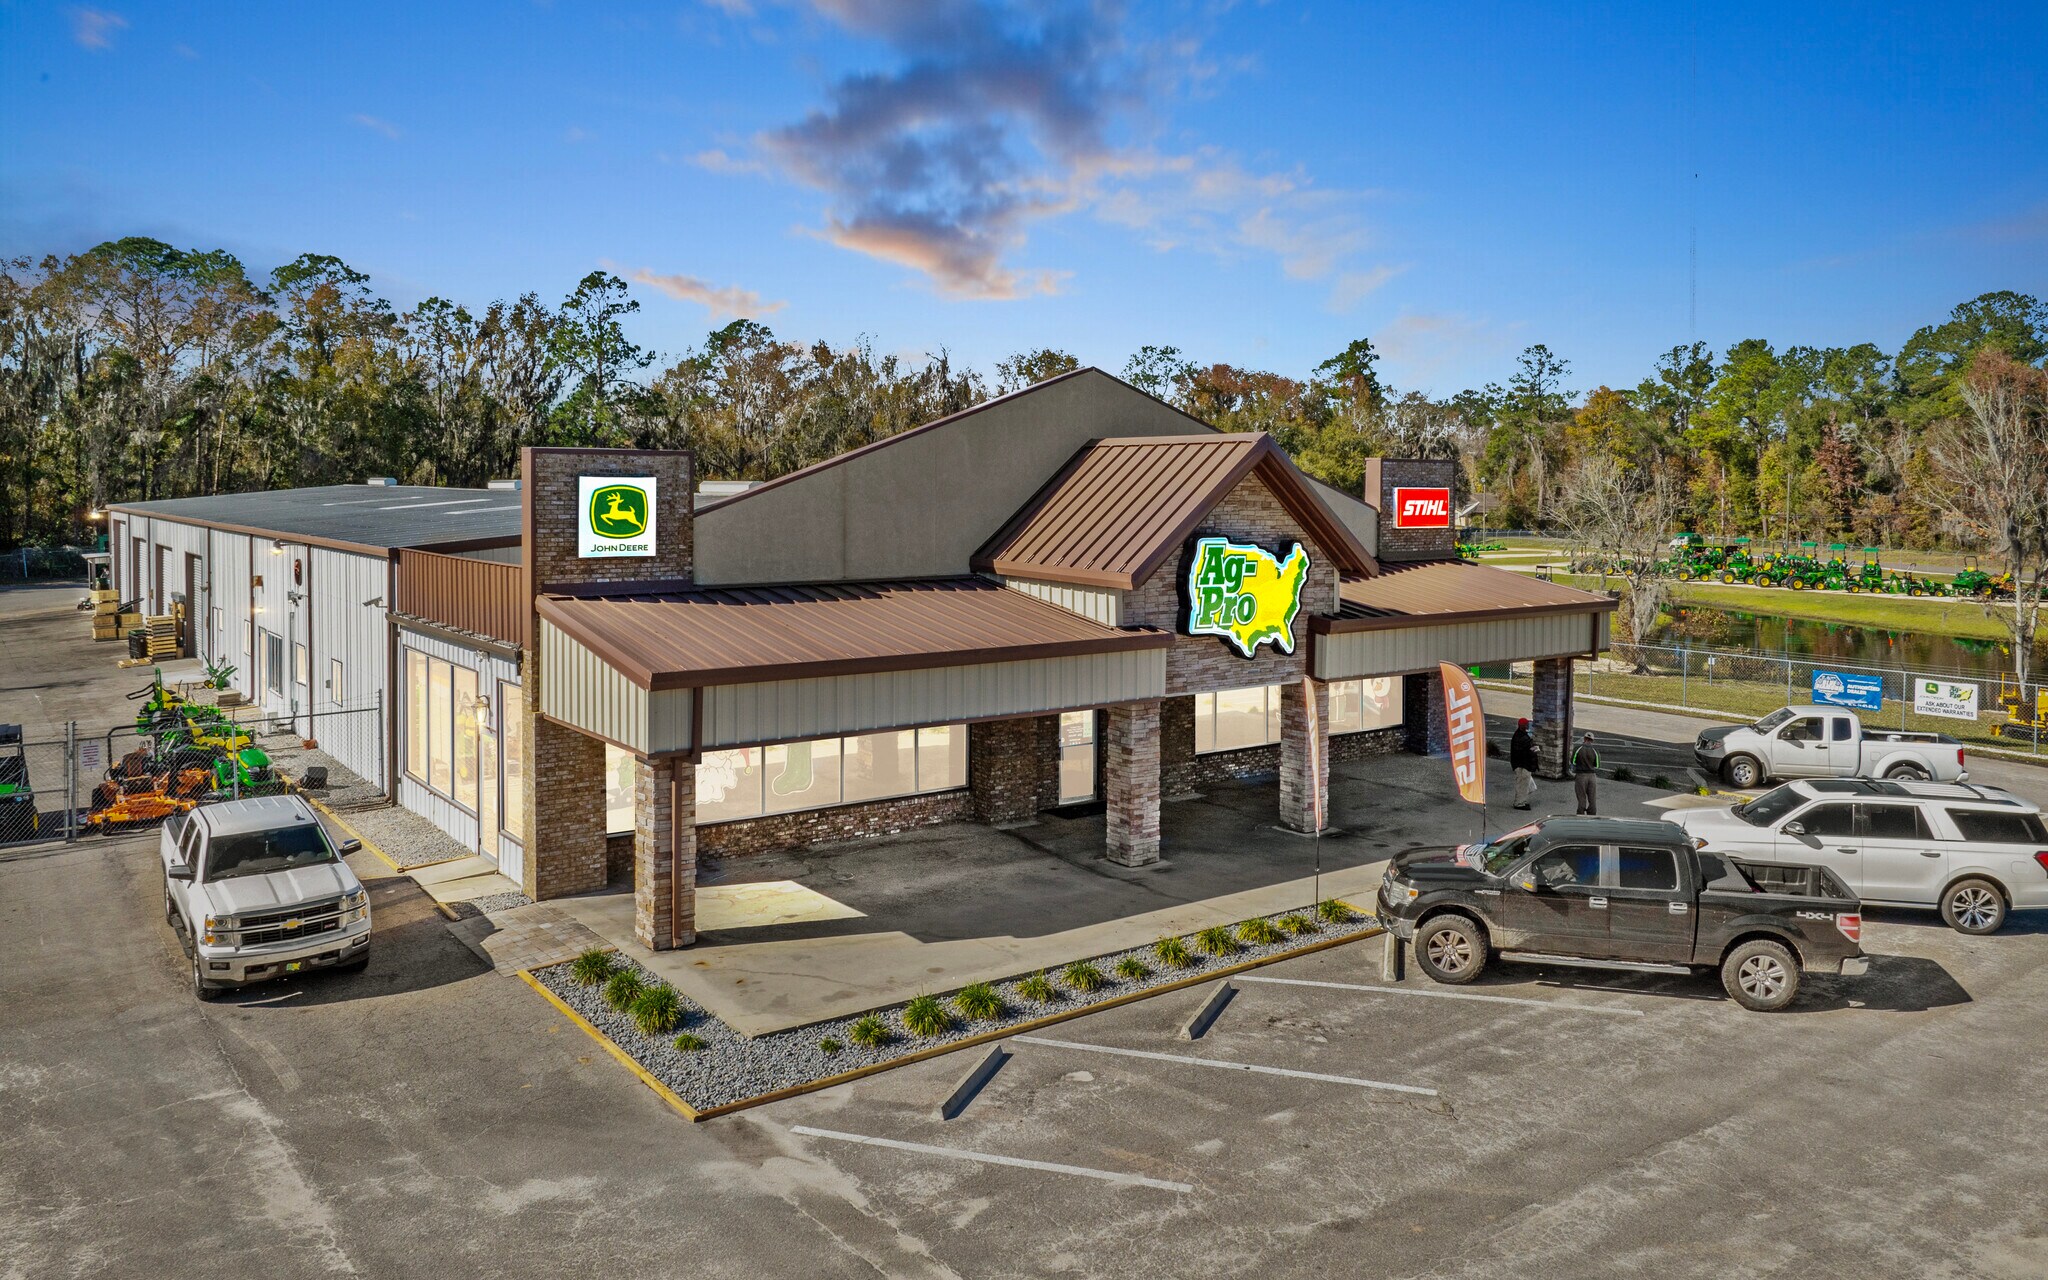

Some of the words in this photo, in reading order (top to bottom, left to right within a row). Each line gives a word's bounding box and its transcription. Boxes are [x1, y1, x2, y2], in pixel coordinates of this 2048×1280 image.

[1403, 500, 1447, 516] STIHL
[590, 544, 618, 552] JOHN
[619, 544, 648, 552] DEERE
[1196, 543, 1258, 594] Ag-
[1195, 585, 1257, 628] Pro
[1942, 709, 1974, 717] WARRANTIES
